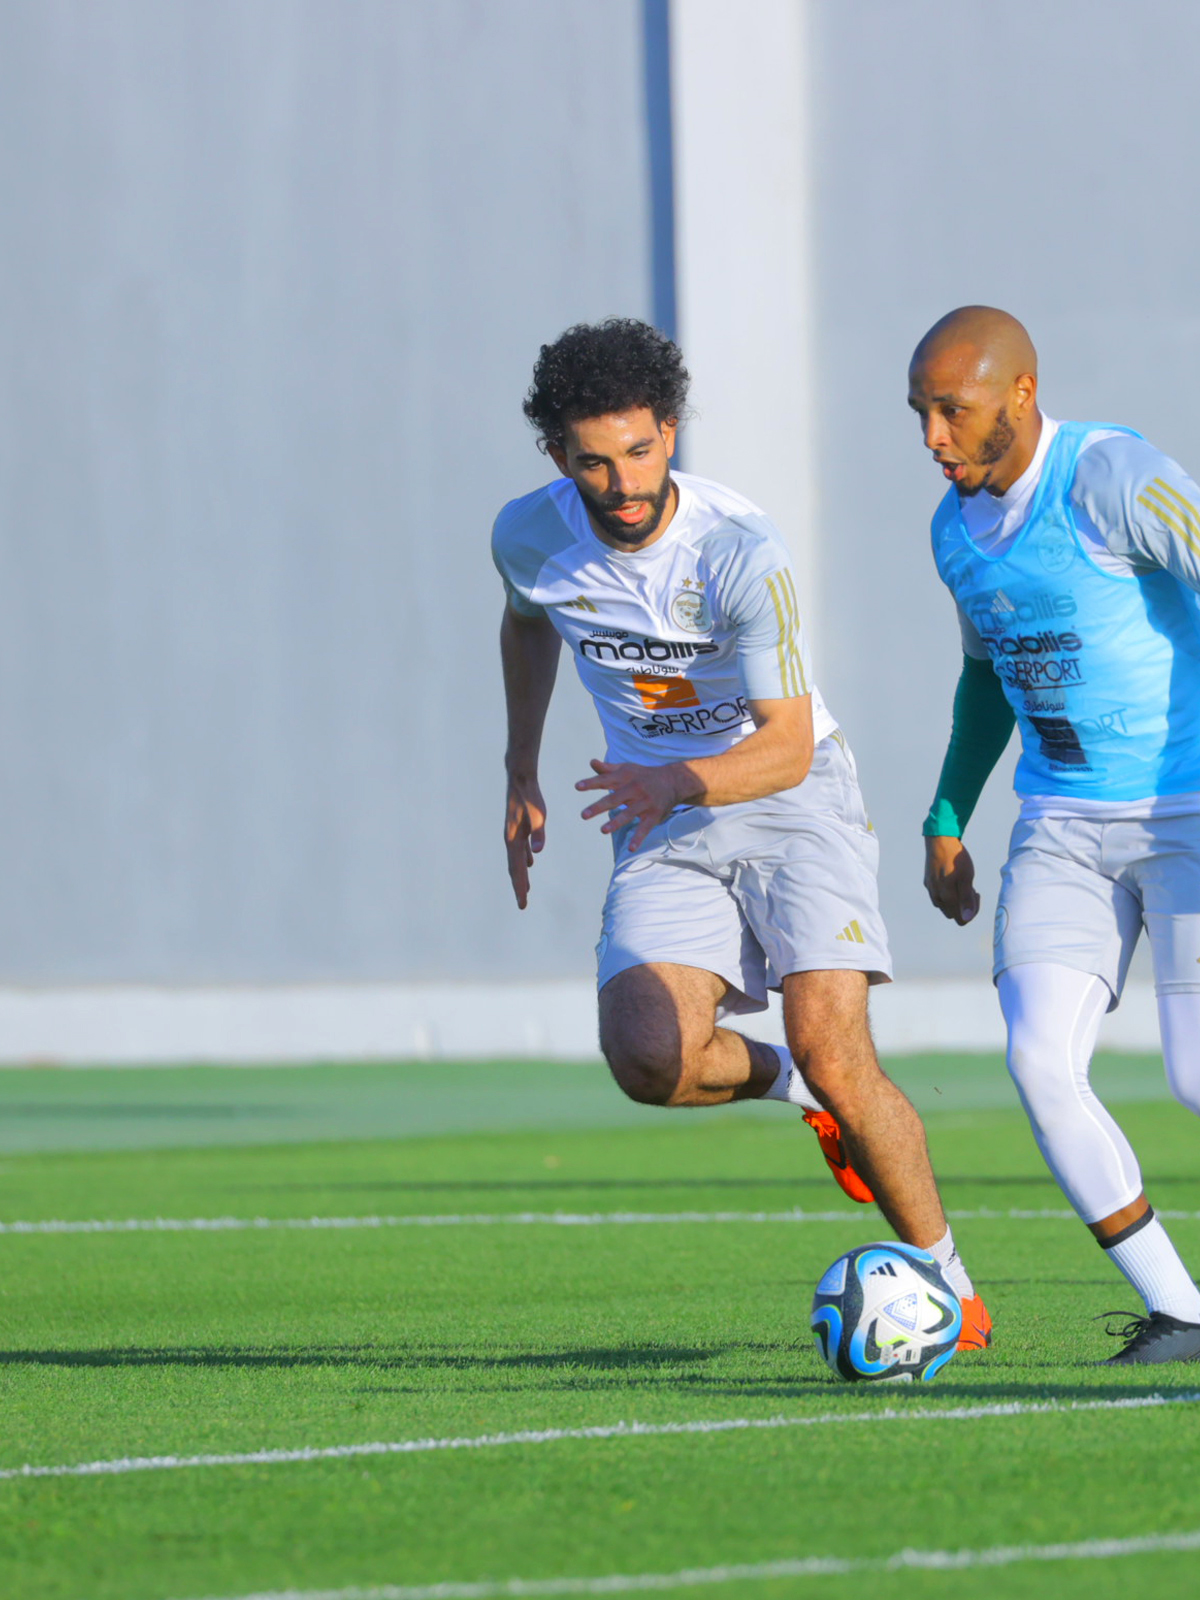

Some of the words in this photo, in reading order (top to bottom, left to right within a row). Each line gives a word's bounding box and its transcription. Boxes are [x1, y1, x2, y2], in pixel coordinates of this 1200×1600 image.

[579, 638, 719, 661] mobilis
[1006, 658, 1082, 684] SERPORT
[651, 696, 749, 733] SERPOR
